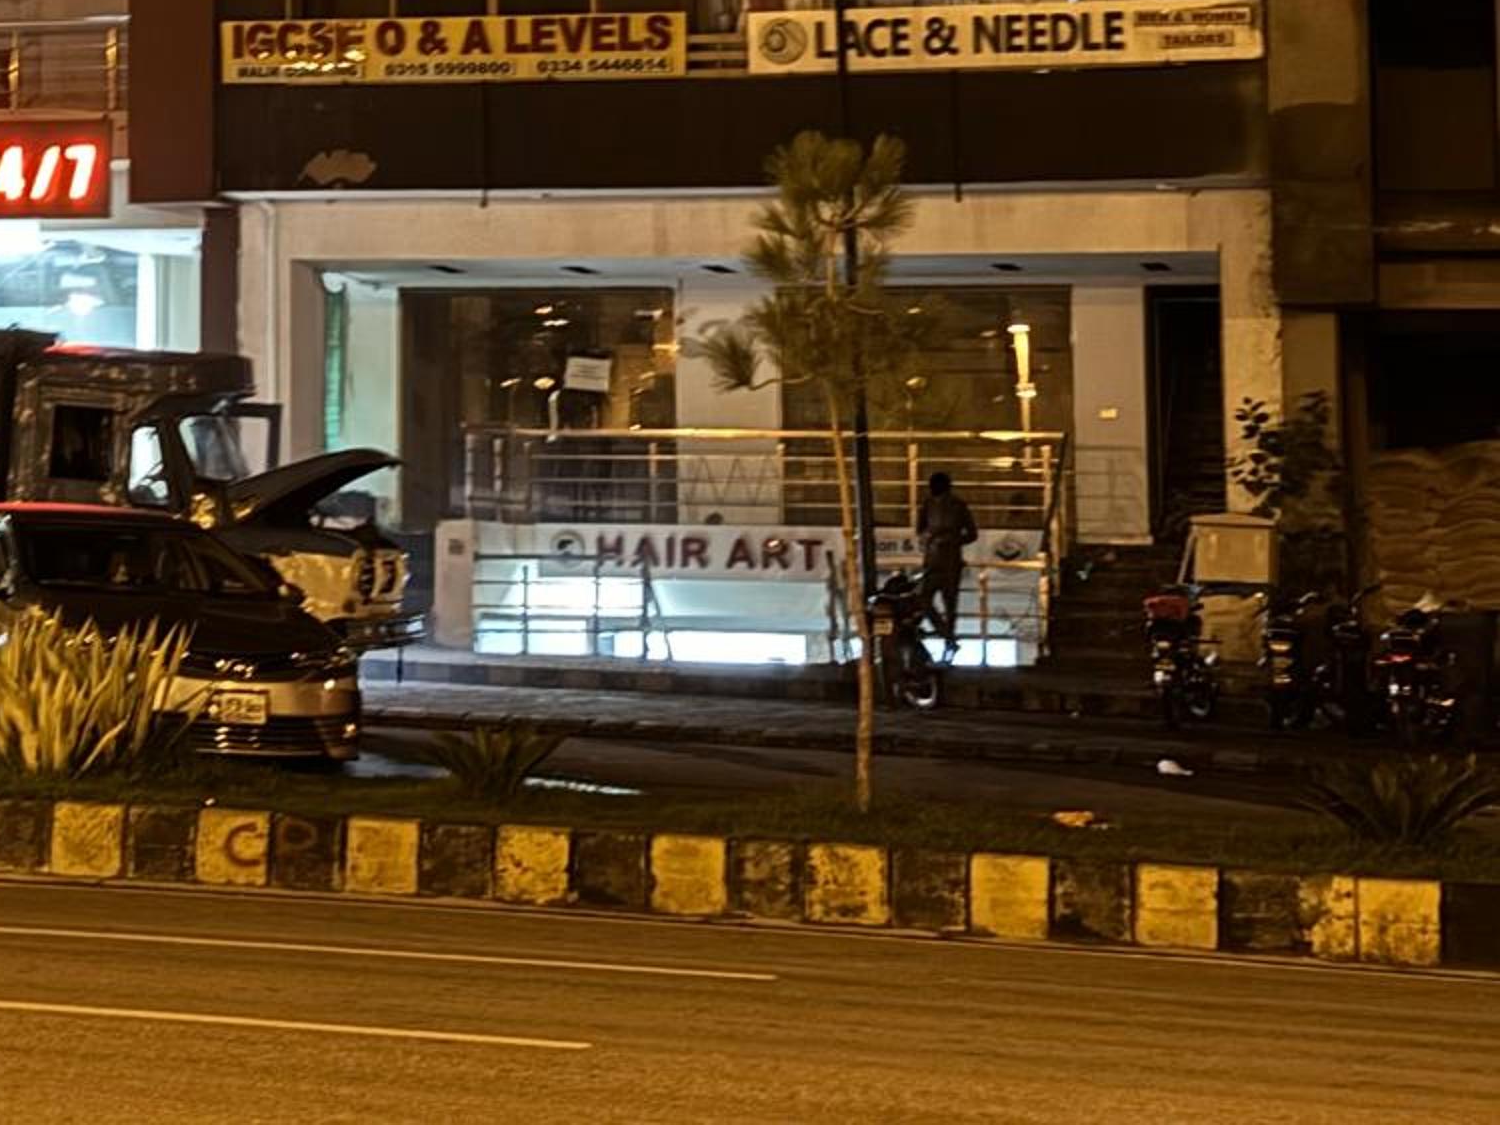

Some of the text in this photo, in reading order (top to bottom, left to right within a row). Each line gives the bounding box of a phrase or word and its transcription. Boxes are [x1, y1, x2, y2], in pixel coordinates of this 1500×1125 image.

[232, 13, 673, 61] IGCSE O & A LEVELS
[814, 11, 1126, 60] LACE & NEEDLE
[598, 531, 825, 573] HAIR ART
